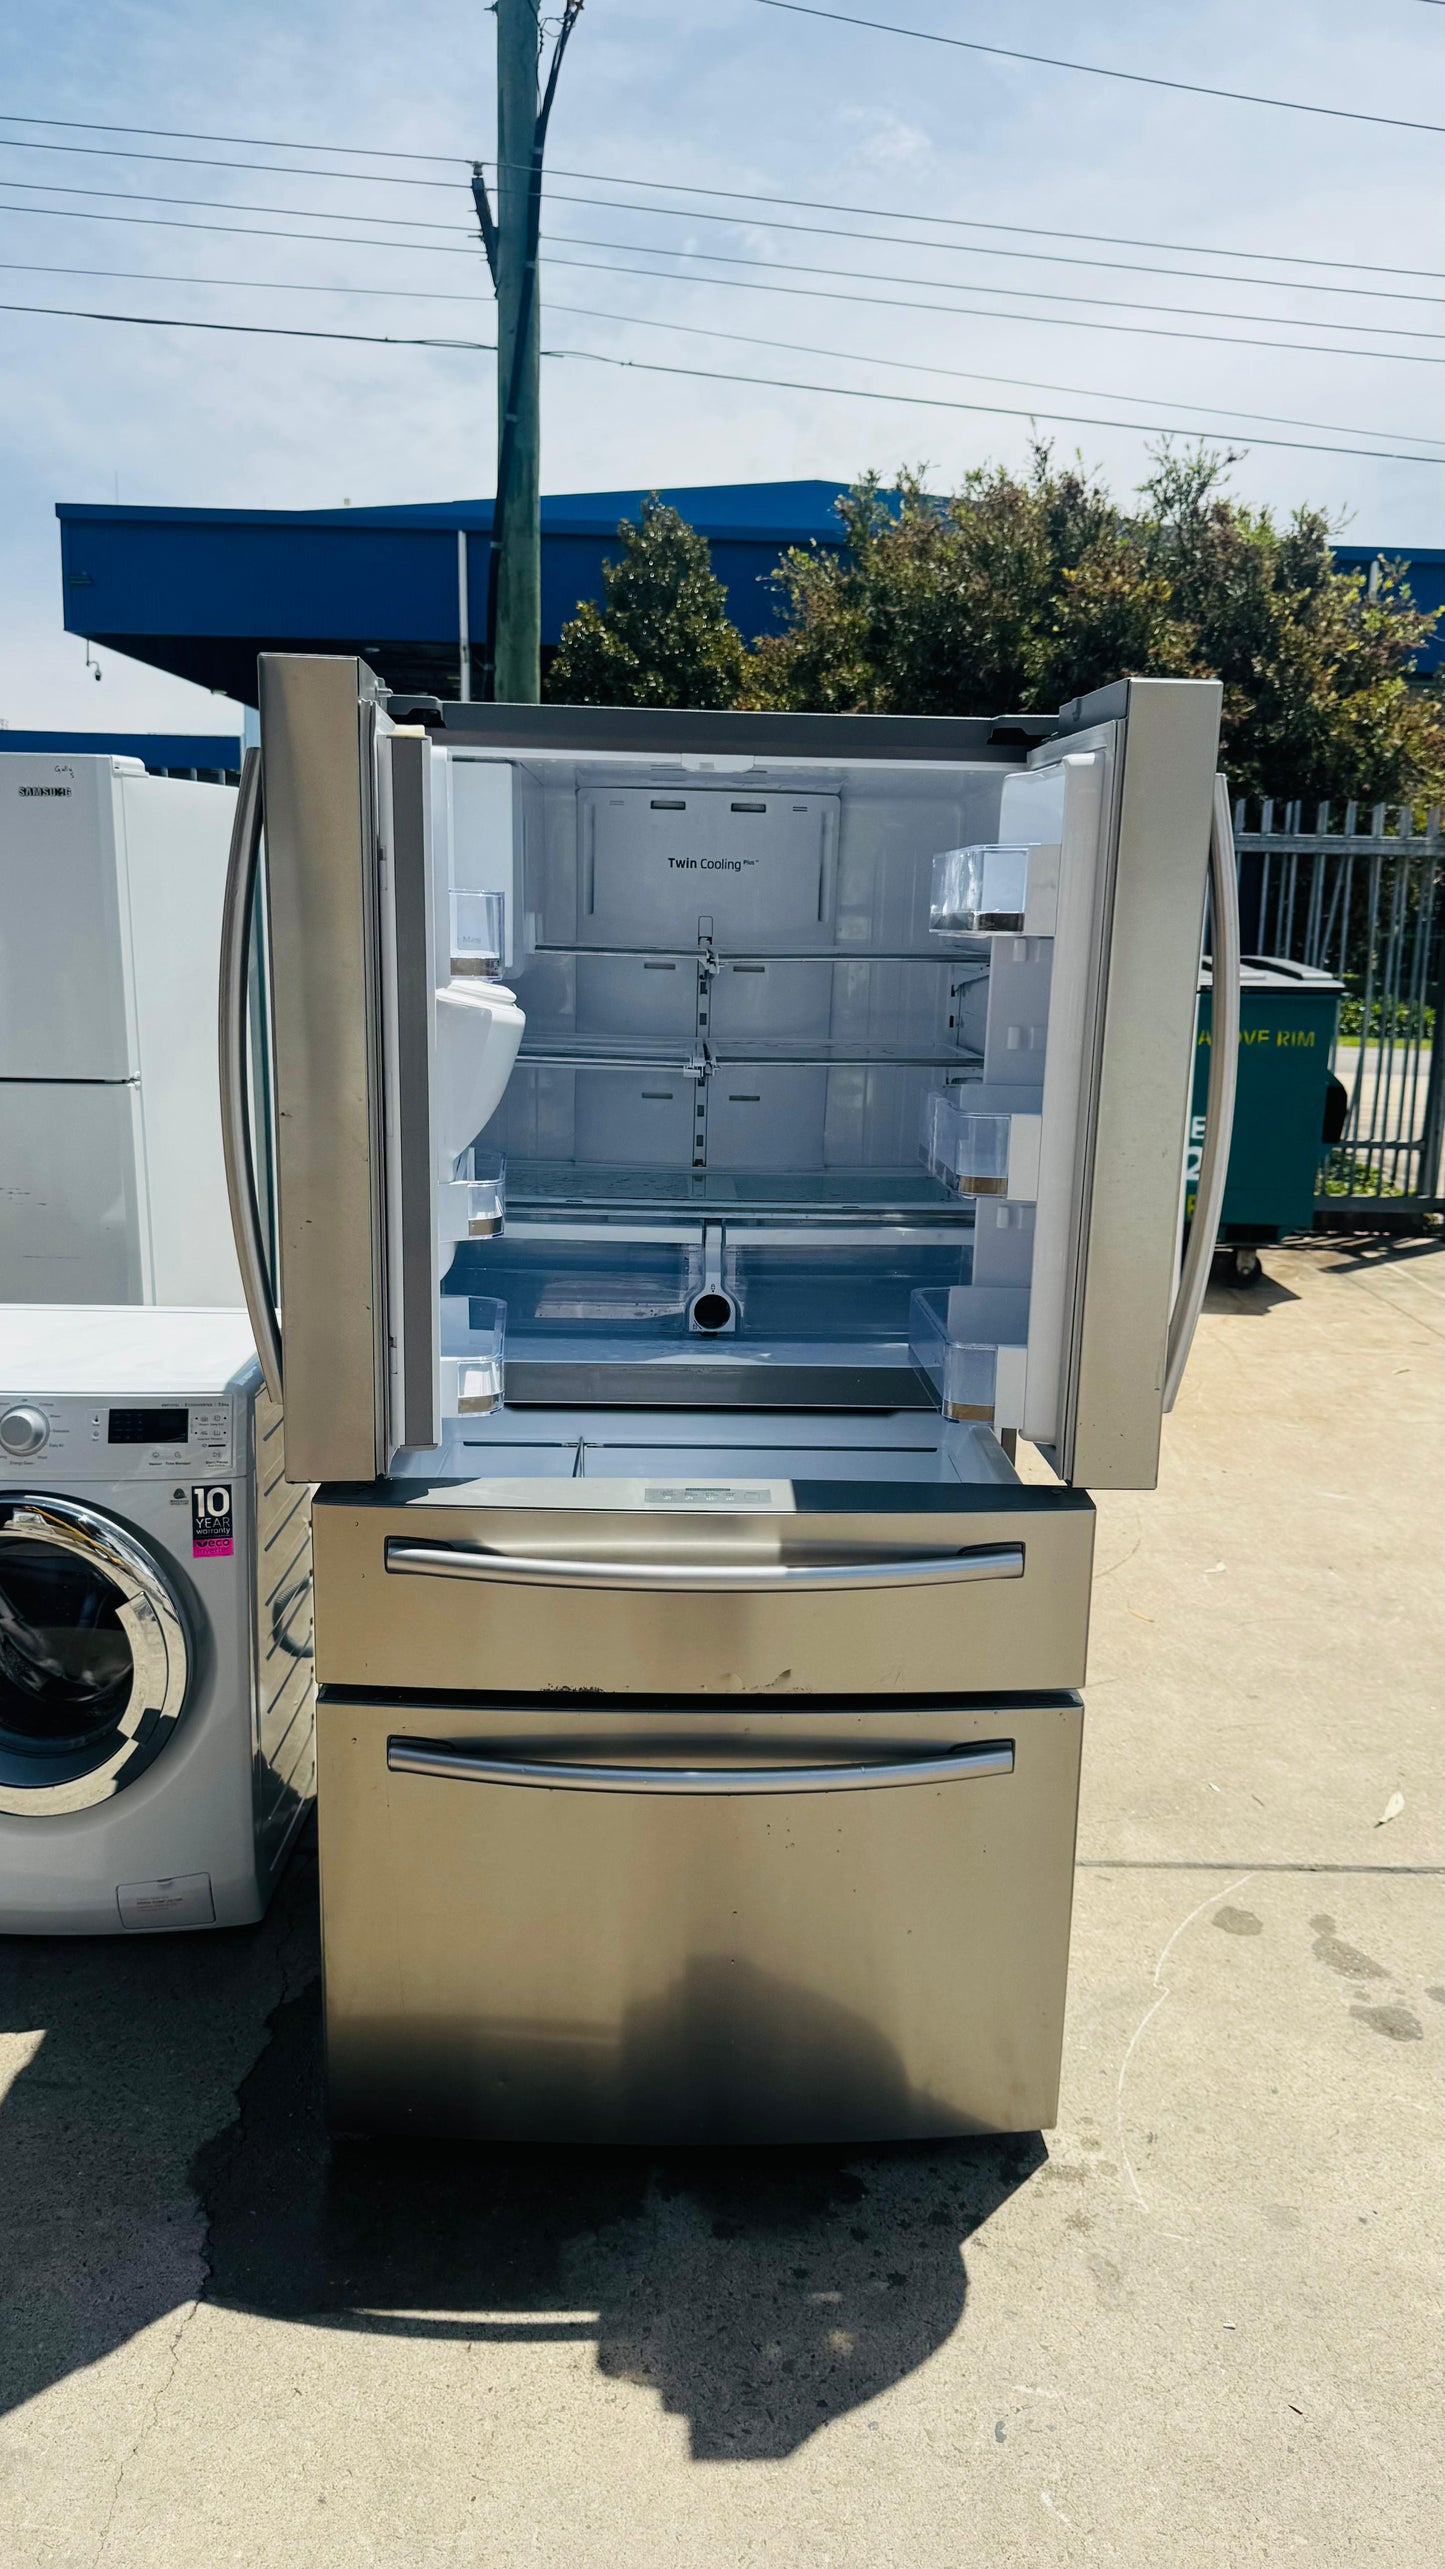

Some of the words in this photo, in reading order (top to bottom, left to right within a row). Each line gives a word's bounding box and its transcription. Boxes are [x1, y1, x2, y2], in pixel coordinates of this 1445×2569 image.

[668, 857, 697, 869] Twin
[700, 858, 741, 872] Cooling
[1277, 1030, 1315, 1047] RIM
[194, 1487, 230, 1517] 10
[195, 1516, 231, 1528] YEAR
[196, 1527, 231, 1535] warranty
[208, 1539, 230, 1547] eco
